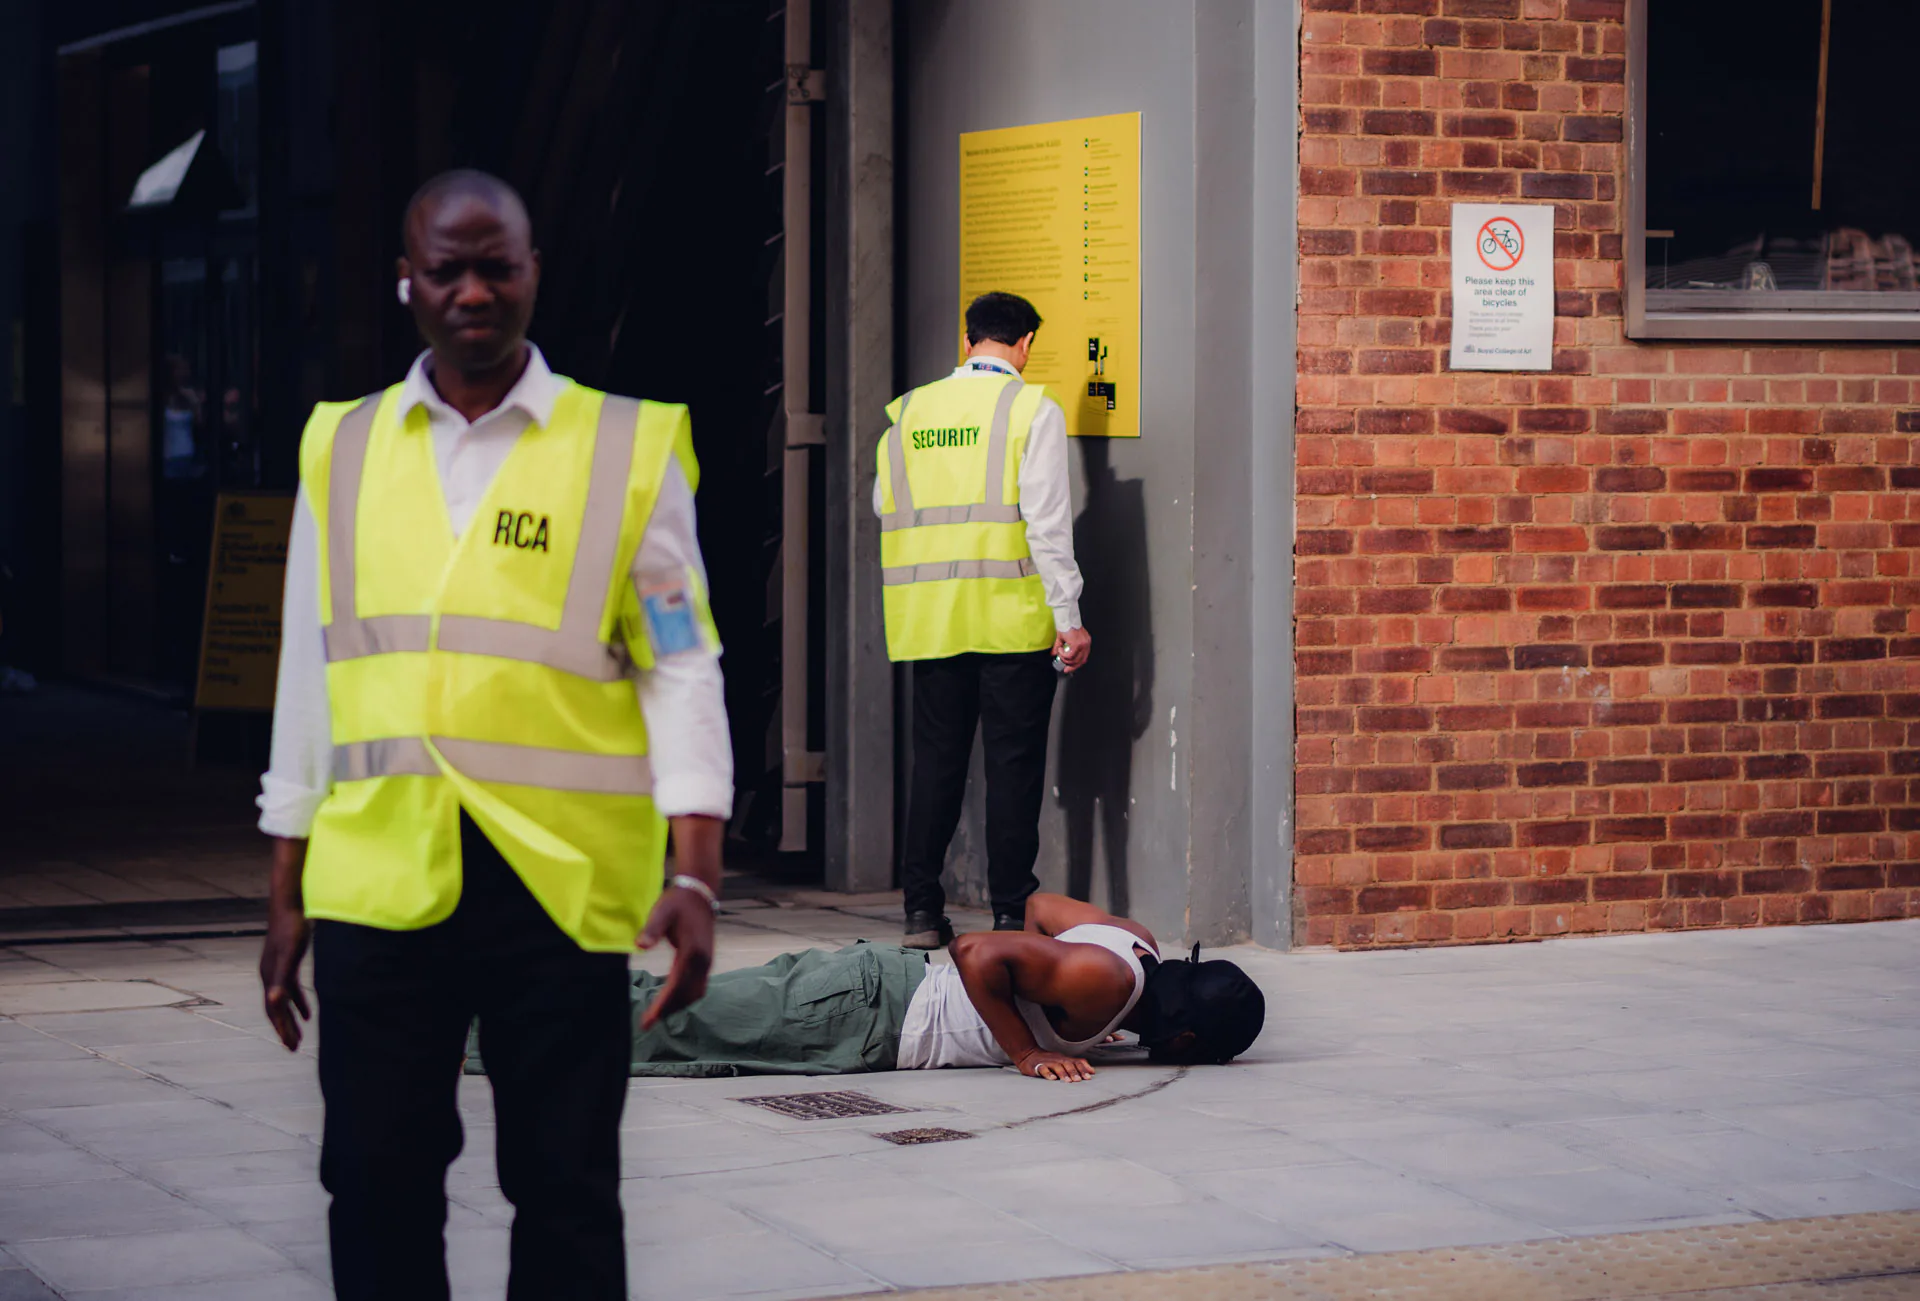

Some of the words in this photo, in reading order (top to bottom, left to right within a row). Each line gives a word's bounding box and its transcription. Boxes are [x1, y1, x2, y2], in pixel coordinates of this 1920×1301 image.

[1465, 276, 1493, 285] Please
[1495, 277, 1516, 286] keep
[1518, 278, 1535, 286] this
[1495, 288, 1516, 296] clear
[1518, 288, 1527, 296] of
[1482, 298, 1517, 307] bicycles
[912, 426, 980, 450] SECURITY
[493, 510, 548, 553] RCA
